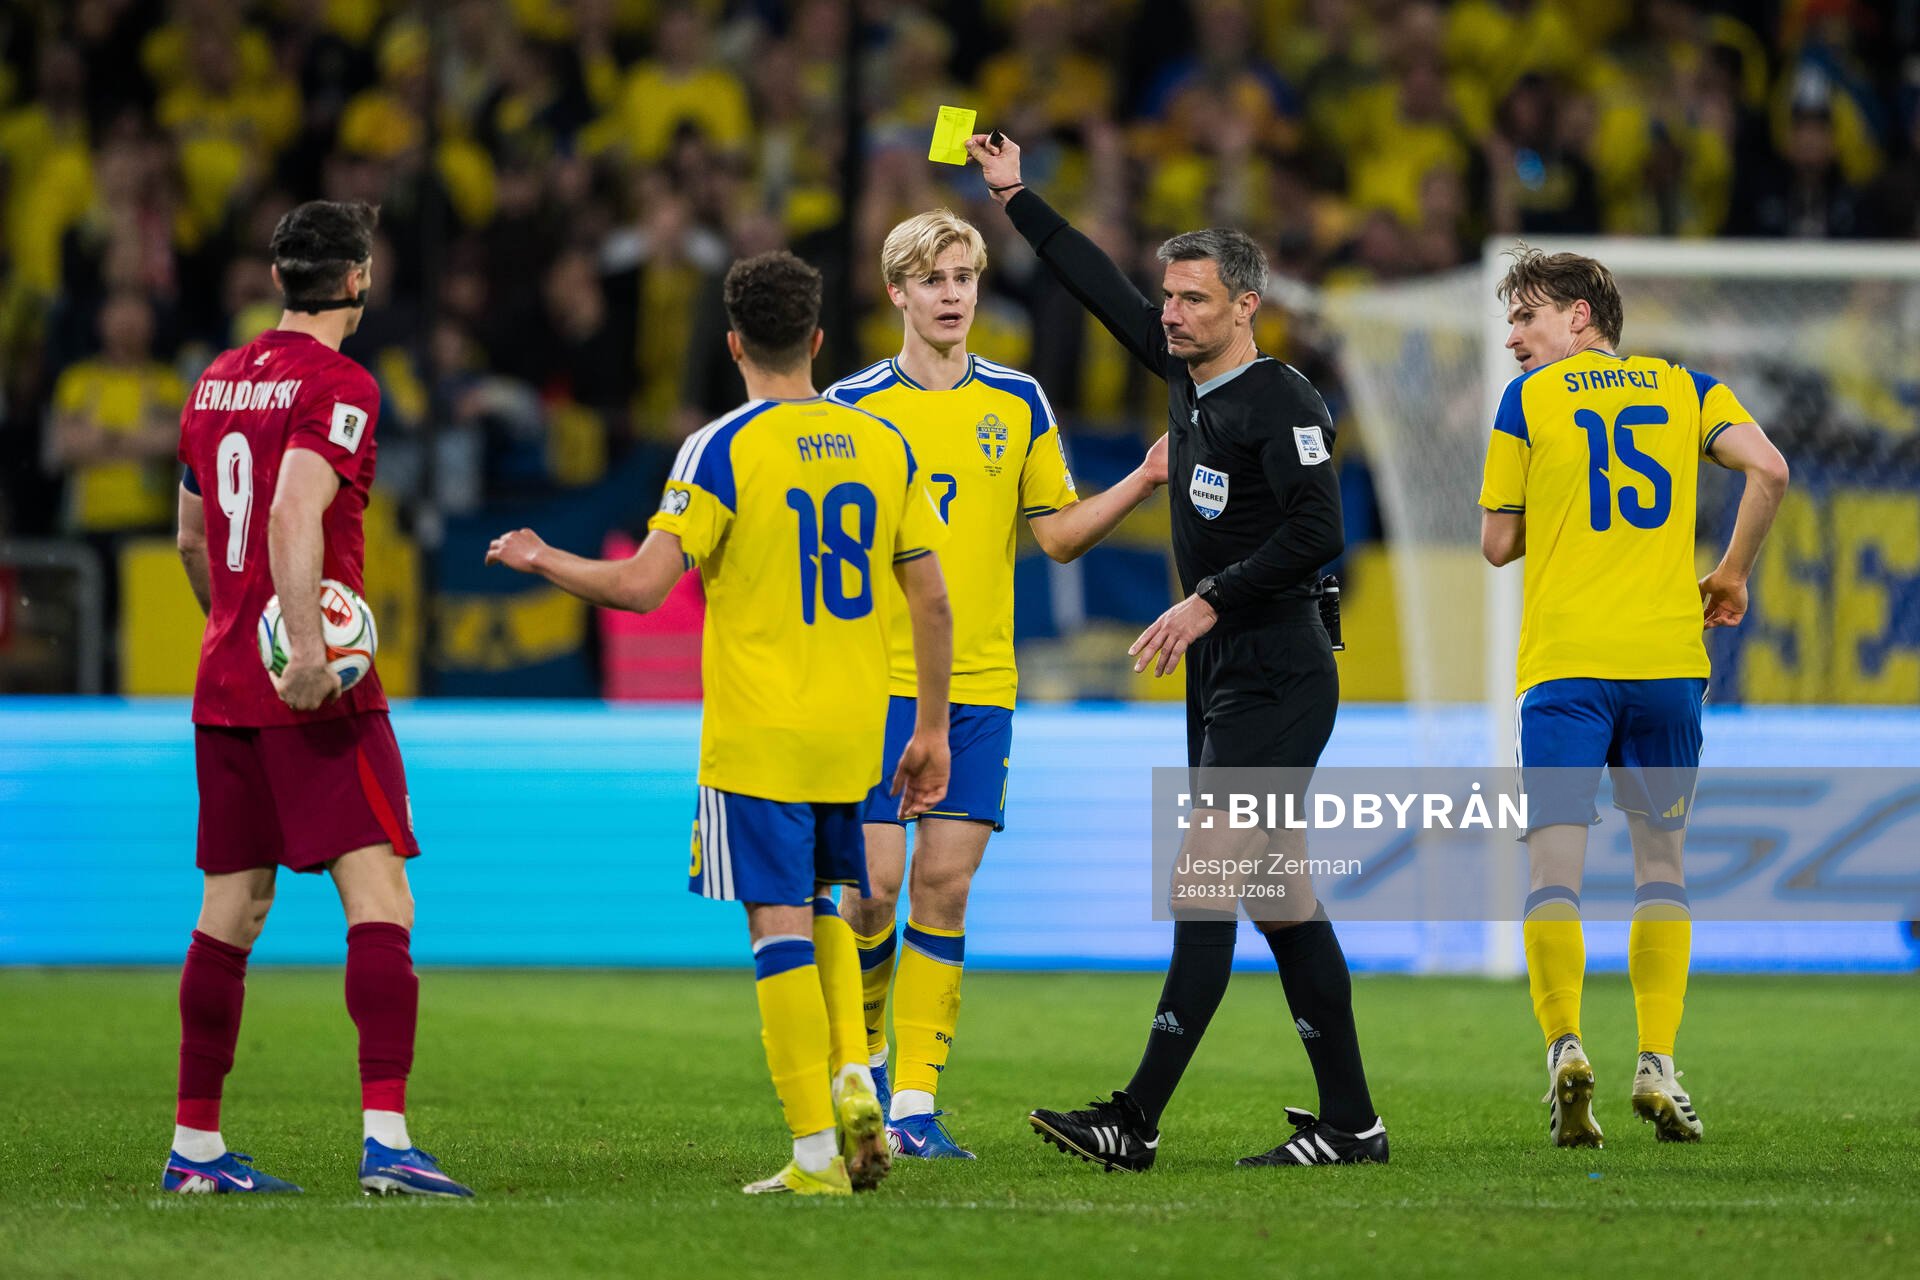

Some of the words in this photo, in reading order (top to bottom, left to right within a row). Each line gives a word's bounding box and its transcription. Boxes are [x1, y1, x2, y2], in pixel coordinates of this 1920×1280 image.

[1564, 369, 1659, 393] STARFELT
[797, 433, 857, 462] AYARI
[1195, 468, 1225, 488] FIFA
[1574, 405, 1672, 532] 15
[217, 432, 253, 572] 9
[931, 473, 957, 526] 7
[1192, 489, 1224, 503] REFEREE
[786, 482, 877, 625] 18
